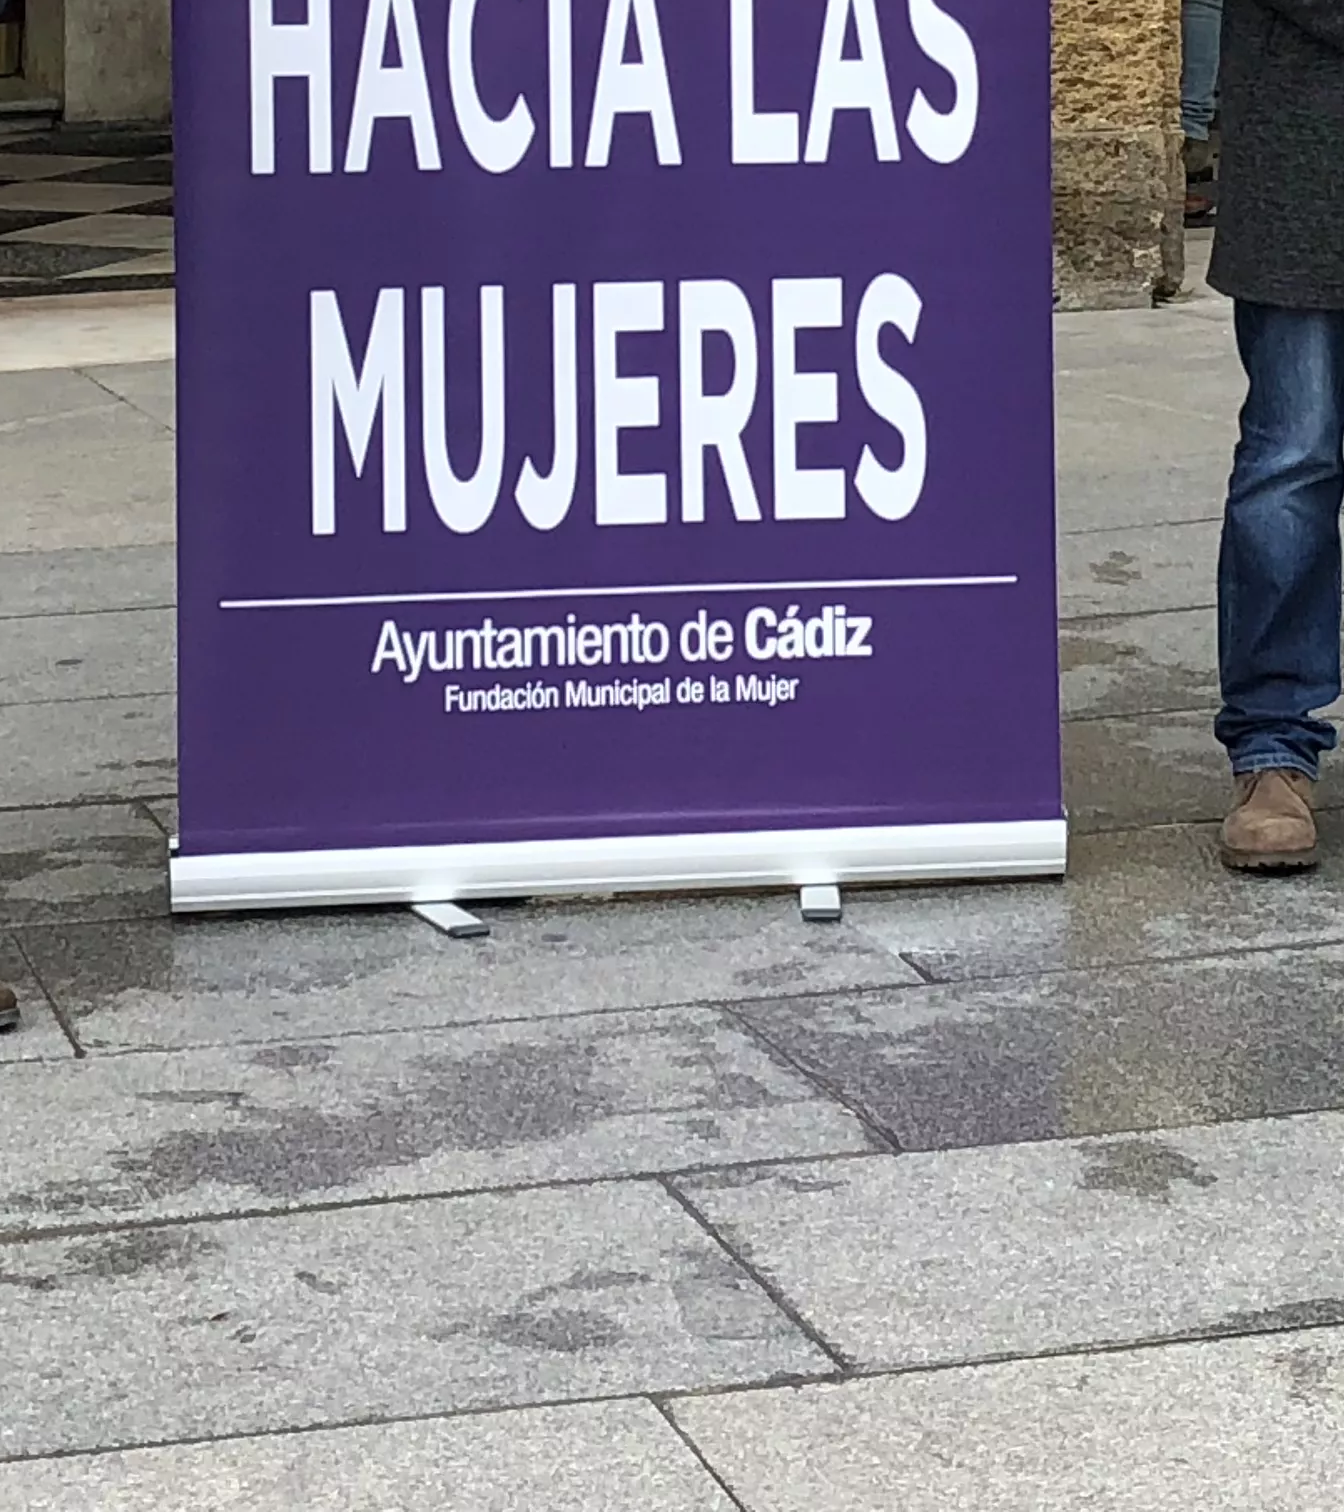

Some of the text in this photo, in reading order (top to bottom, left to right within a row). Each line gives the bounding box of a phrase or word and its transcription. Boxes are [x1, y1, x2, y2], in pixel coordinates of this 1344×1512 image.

[310, 273, 927, 535] MUJERES
[370, 604, 874, 683] Ayuntamiento de Cádiz
[444, 673, 801, 713] Fundación Municipal de la Mujer
